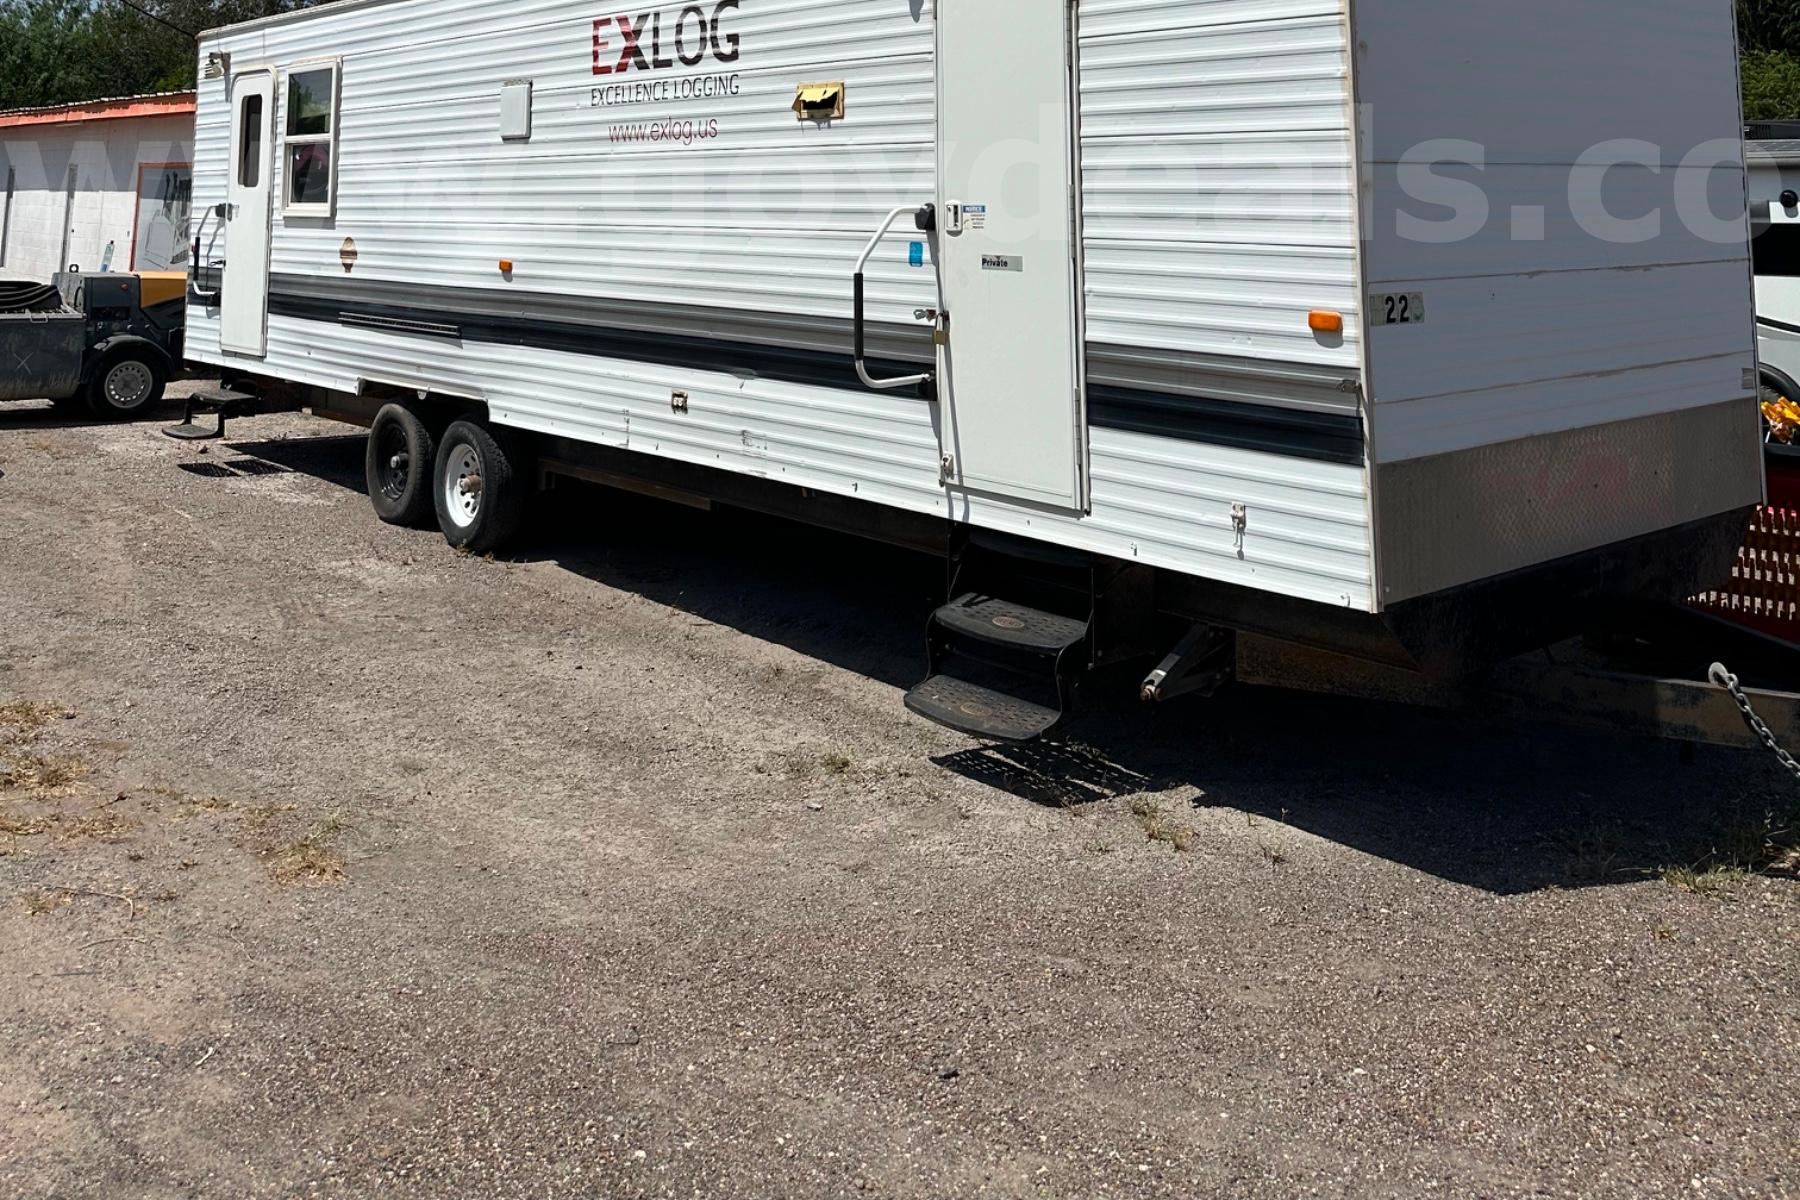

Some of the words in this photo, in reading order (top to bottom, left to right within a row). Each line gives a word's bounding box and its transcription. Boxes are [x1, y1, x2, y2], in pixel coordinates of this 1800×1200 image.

[591, 81, 669, 107] EXCELLENCE
[674, 74, 740, 99] LOGGING
[608, 116, 718, 145] www.exlog.us
[981, 258, 1008, 268] Private
